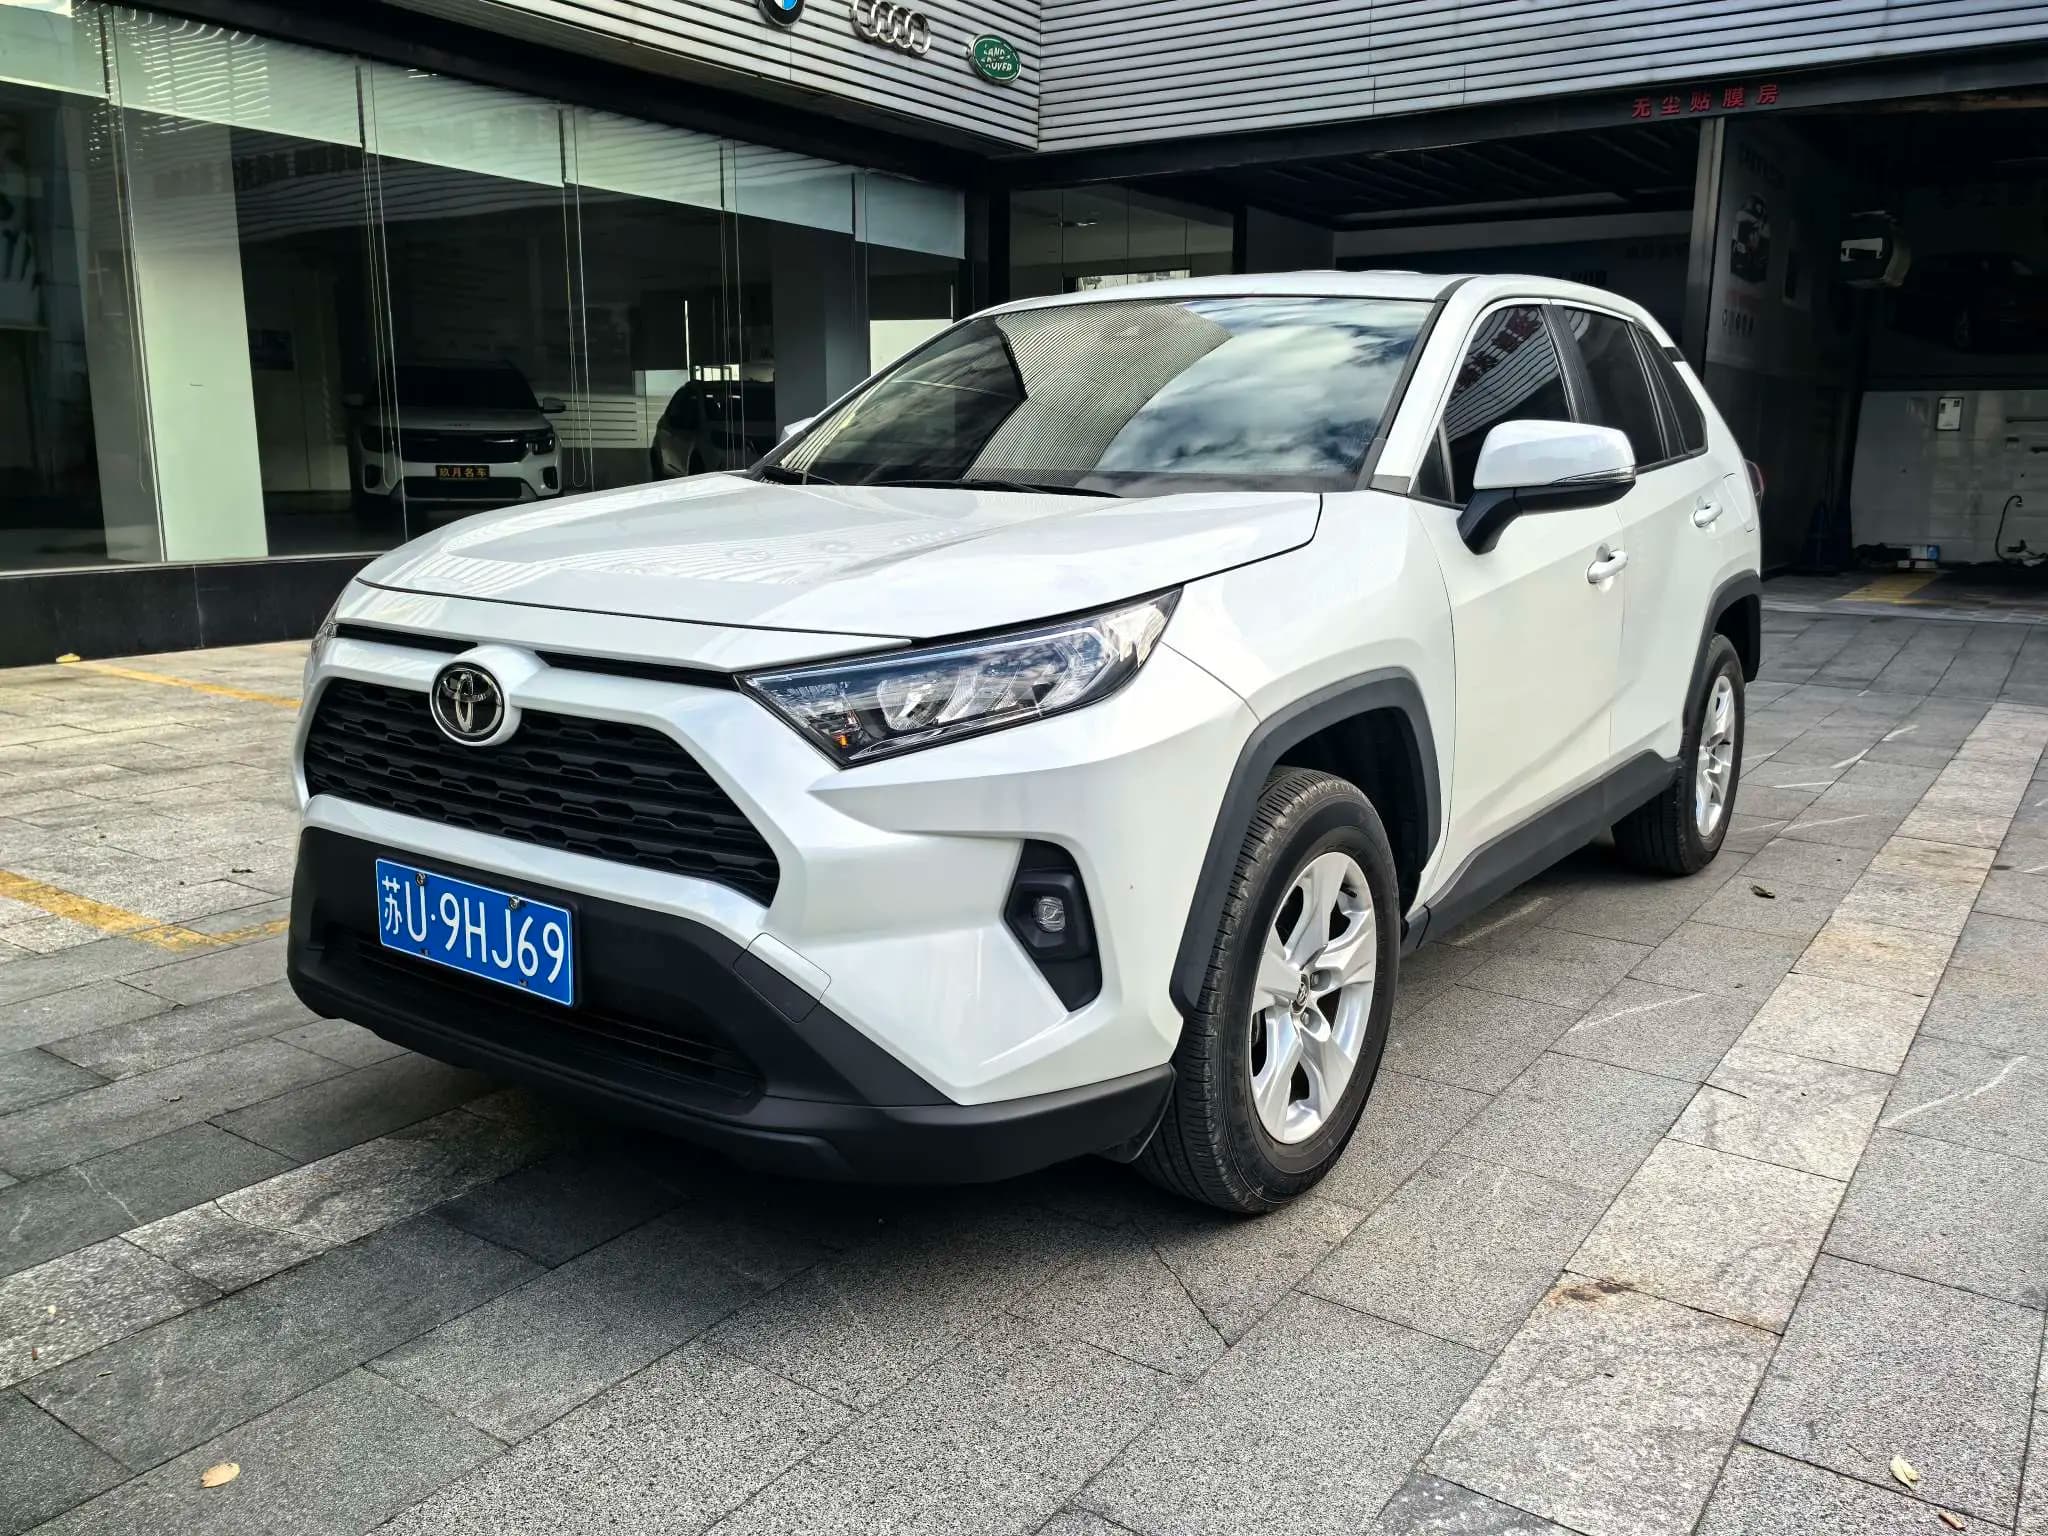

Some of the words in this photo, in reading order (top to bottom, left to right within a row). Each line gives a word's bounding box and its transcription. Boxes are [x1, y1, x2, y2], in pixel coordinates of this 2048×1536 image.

[1632, 84, 1778, 118] 无尘贴膜房
